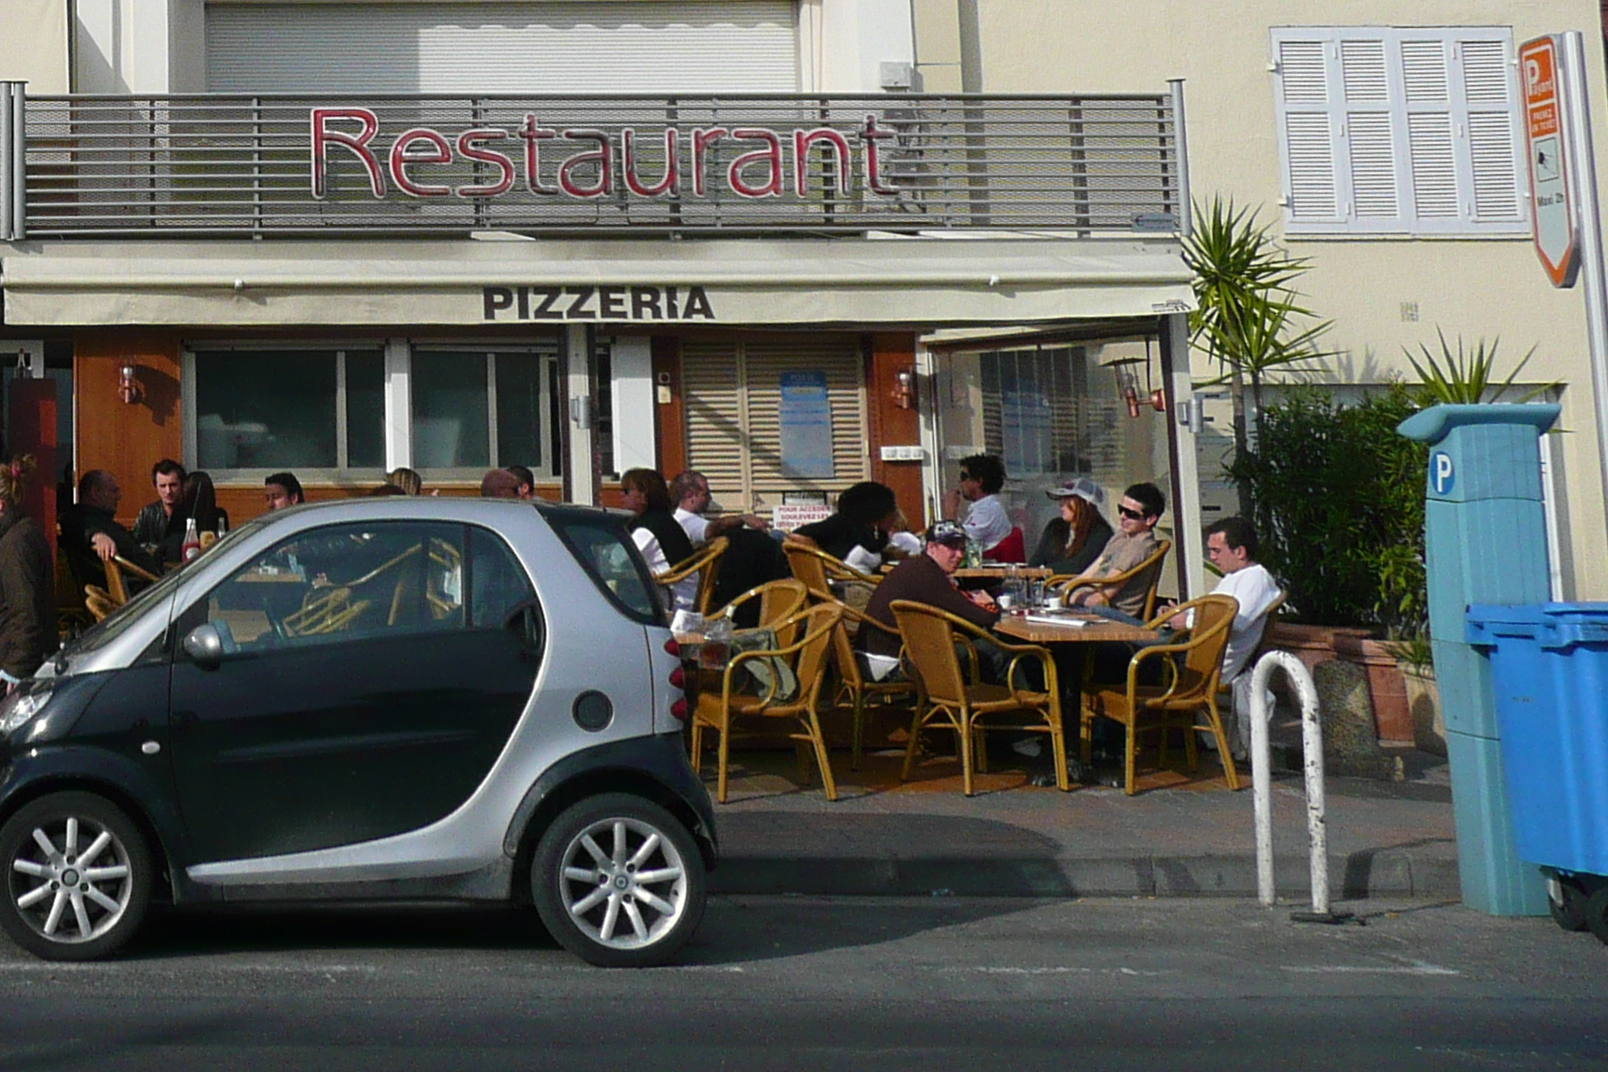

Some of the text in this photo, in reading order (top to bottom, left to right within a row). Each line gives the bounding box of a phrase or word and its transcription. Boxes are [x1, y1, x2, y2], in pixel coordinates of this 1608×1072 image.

[1526, 59, 1554, 97] Payant
[310, 108, 899, 199] Restaurant
[1537, 194, 1554, 207] Maxi
[483, 286, 715, 320] PIZZERIA
[1436, 454, 1452, 492] P
